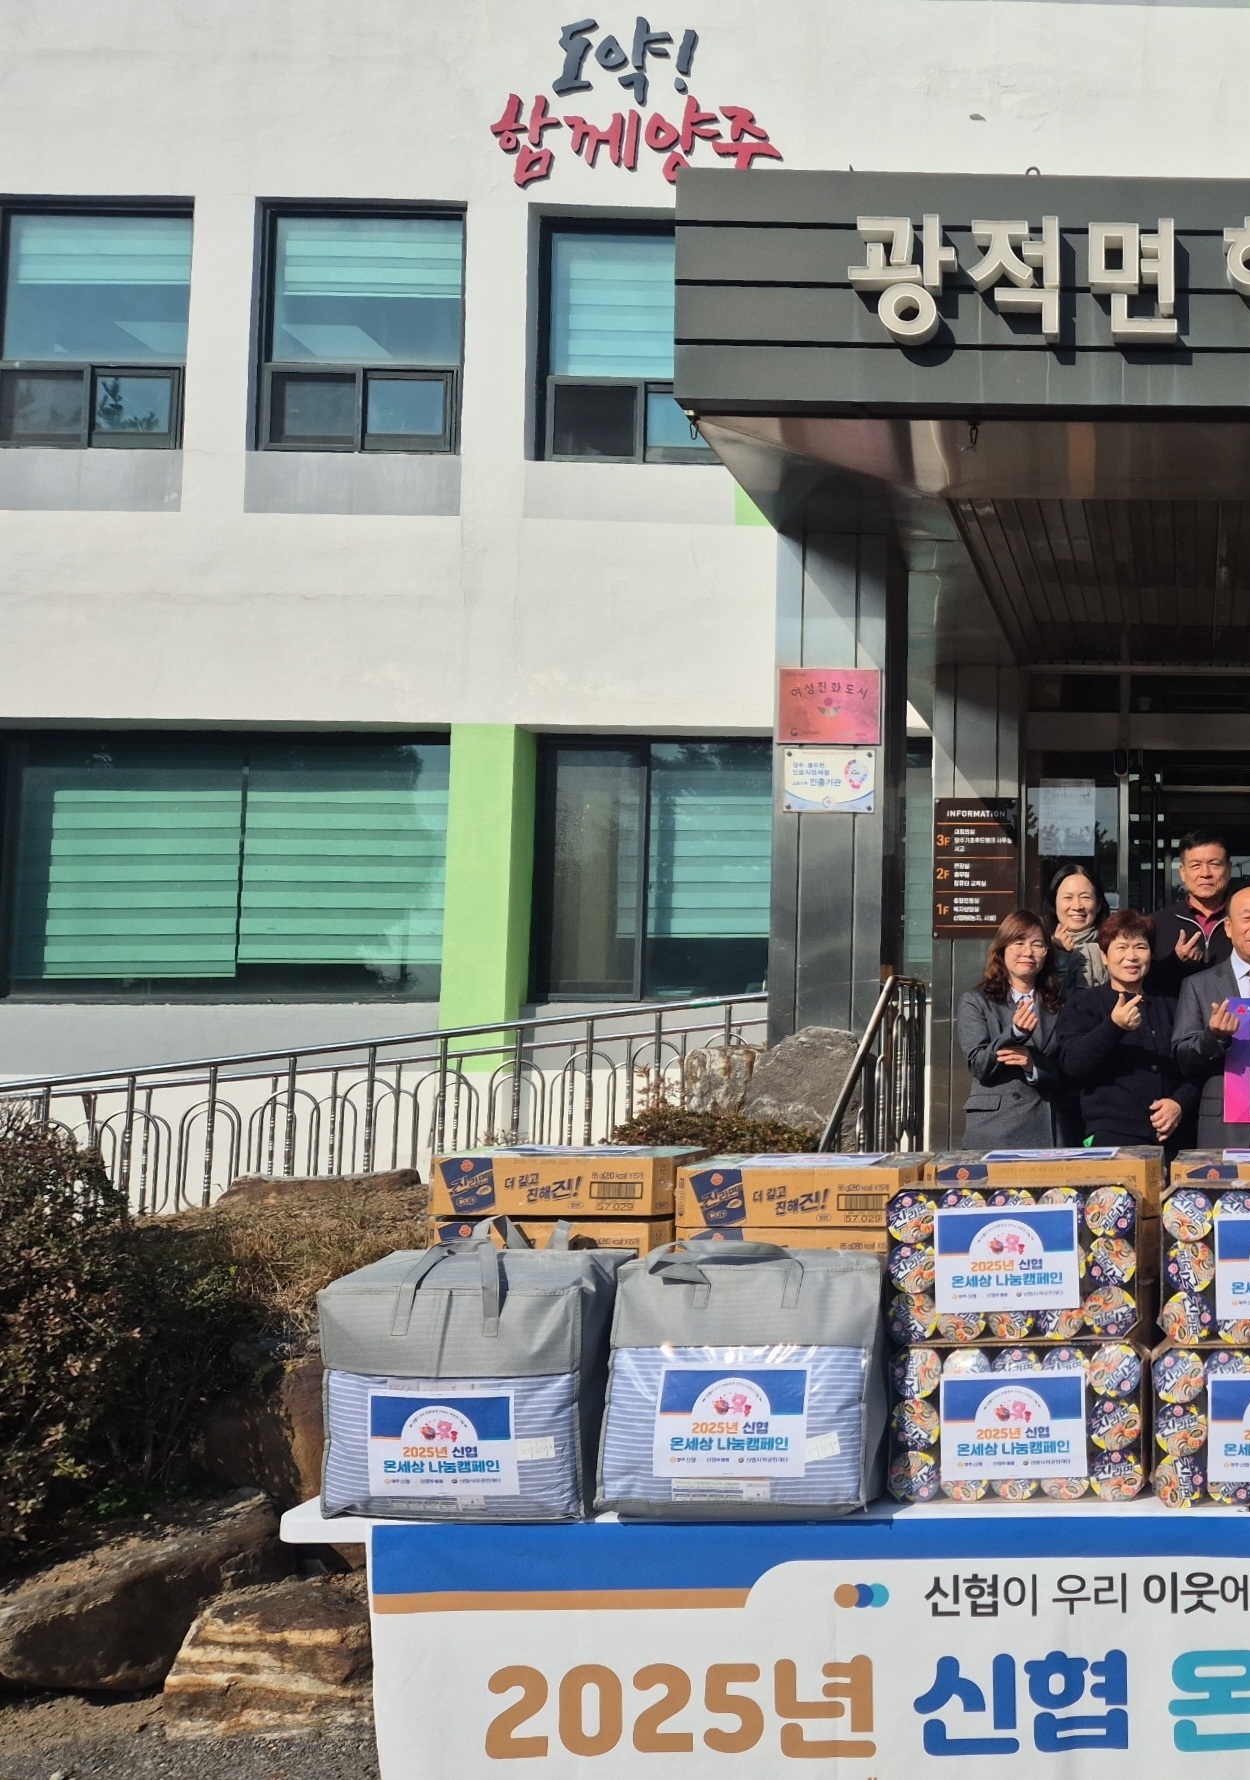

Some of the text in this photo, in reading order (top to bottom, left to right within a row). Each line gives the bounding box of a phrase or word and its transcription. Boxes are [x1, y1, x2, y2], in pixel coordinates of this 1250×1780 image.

[553, 15, 699, 106] 도약!
[848, 214, 1178, 345] 광적면
[946, 810, 1006, 818] INFORMATION
[936, 834, 950, 846] 3F
[936, 867, 950, 879] 2F
[936, 903, 949, 915] 1F
[971, 1258, 1042, 1272] 2025년 신협
[951, 1271, 1062, 1288] 온세상 나눔캠페인
[691, 1421, 768, 1434] 2025년 신협
[976, 1426, 1050, 1439] 2025년 신협
[670, 1437, 788, 1451] 온세상 나눔캠페인
[957, 1440, 1070, 1456] 온세상 나눔캠페인
[403, 1446, 477, 1458] 2025년 신협
[383, 1459, 500, 1473] 온세상 나눔캠페인
[924, 1573, 1039, 1617] 신협이
[1052, 1573, 1129, 1615] 우리
[485, 1658, 876, 1759] 2025년
[914, 1648, 1129, 1757] 신협
